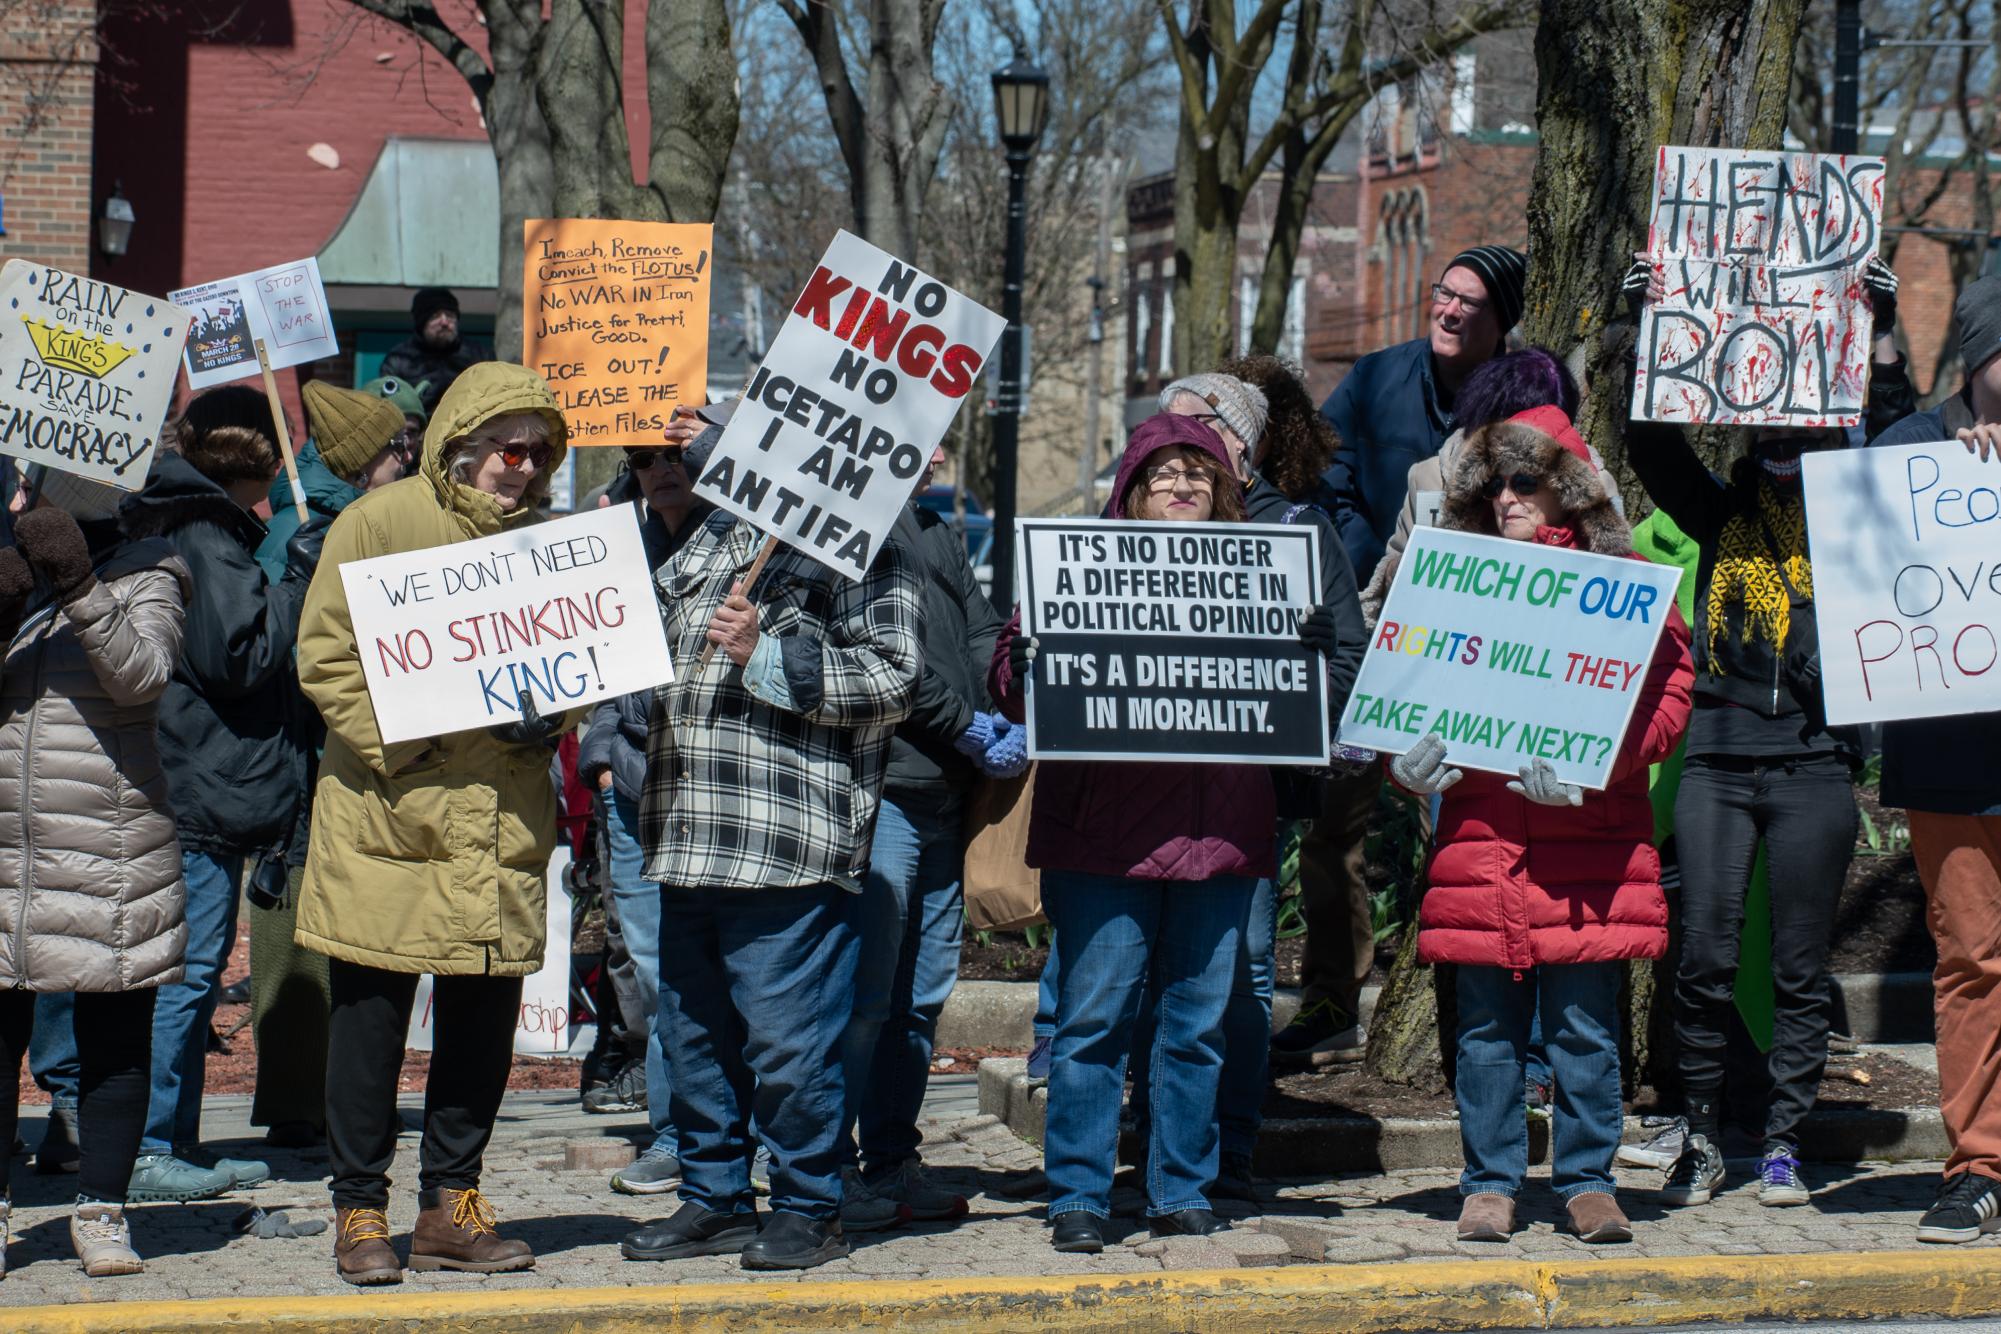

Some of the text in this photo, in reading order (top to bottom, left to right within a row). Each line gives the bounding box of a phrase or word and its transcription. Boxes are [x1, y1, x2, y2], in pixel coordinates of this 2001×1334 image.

[612, 237, 683, 258] Remove
[264, 274, 304, 293] STOP
[603, 263, 628, 275] the
[38, 268, 129, 319] RAIN
[274, 296, 306, 311] THE
[569, 283, 627, 306] WAR
[633, 286, 651, 303] IN
[656, 284, 694, 303] Iran
[877, 260, 948, 318] NO
[55, 307, 113, 336] on the
[279, 312, 314, 330] WAR
[535, 315, 604, 339] Justice
[608, 313, 630, 328] for
[793, 265, 983, 398] KINGS
[47, 330, 108, 368] KING'S
[201, 345, 229, 358] MARCH
[203, 359, 216, 368] NO
[217, 353, 243, 365] KINGS
[542, 346, 670, 381] ICE OUT!
[1644, 310, 1860, 423] ROLL
[16, 358, 133, 421] PARADE
[638, 383, 678, 403] THE
[829, 348, 898, 405] NO
[39, 400, 96, 426] SAVE
[746, 366, 923, 480] ICETAPO
[758, 416, 873, 501] I AM
[699, 455, 873, 572] ANTIFA
[1907, 455, 2001, 541] Peo
[442, 551, 517, 597] DON'T
[530, 535, 608, 577] NEED
[1058, 533, 1274, 568] IT'S NO LONGER
[1055, 567, 1288, 602] A DIFFERENCE IN
[1411, 547, 1659, 625] WHICH OF OUR
[376, 586, 626, 677] NO STINKING
[1043, 600, 1304, 637] POLITICAL OPINION
[1045, 653, 1308, 692] IT'S A DIFFERENCE
[1375, 621, 1643, 692] RIGHTS WILL THEY
[1085, 696, 1275, 735] IN MORALITY.
[1351, 693, 1613, 767] TAKE AWAY NEXT?
